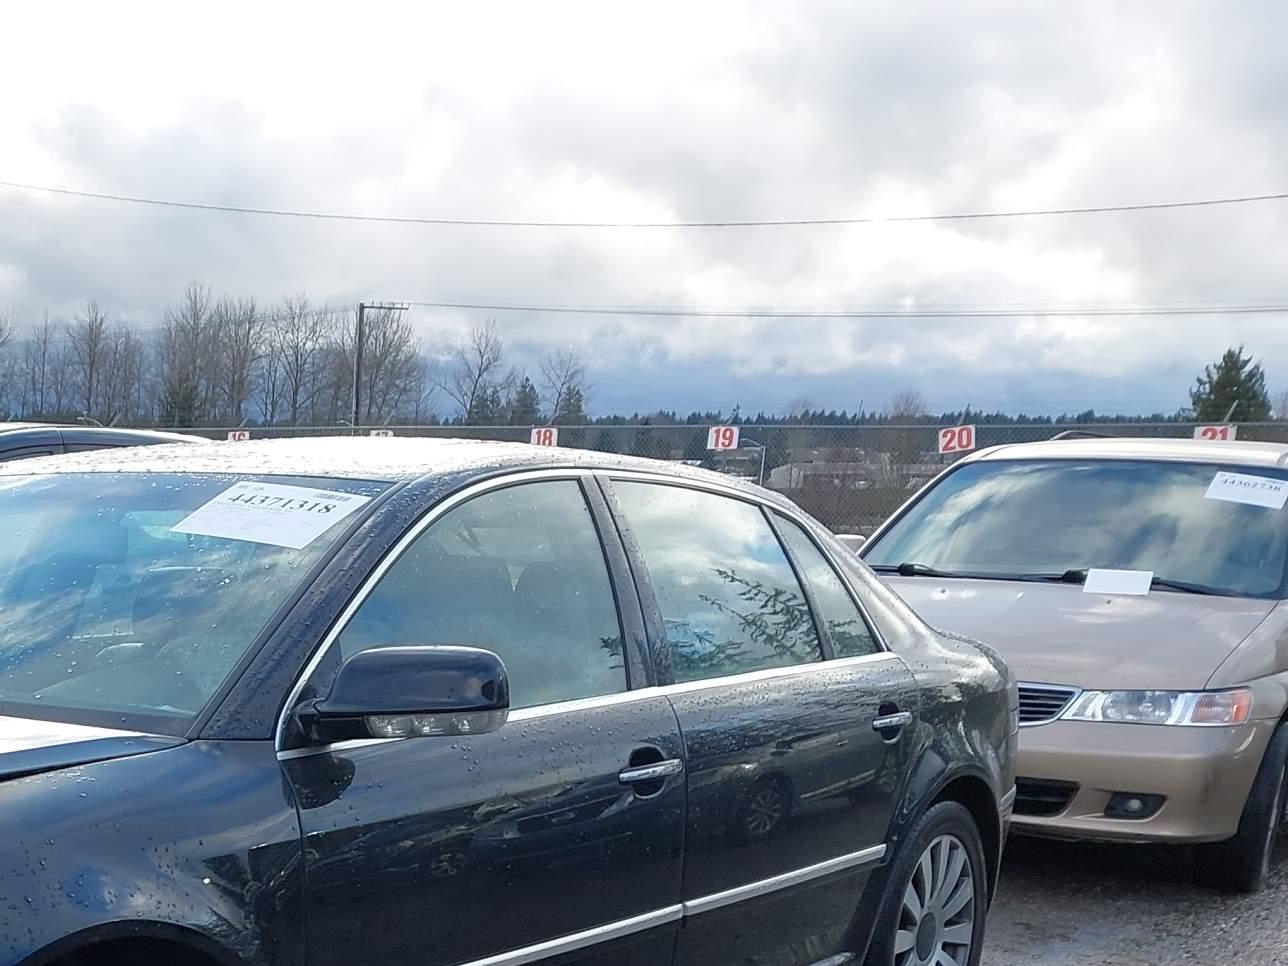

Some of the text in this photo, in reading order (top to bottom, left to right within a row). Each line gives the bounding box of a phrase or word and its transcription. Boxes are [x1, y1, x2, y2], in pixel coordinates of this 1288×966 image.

[535, 429, 553, 446] 18
[713, 427, 735, 448] 19
[942, 427, 972, 451] 20
[228, 493, 336, 514] 44371318
